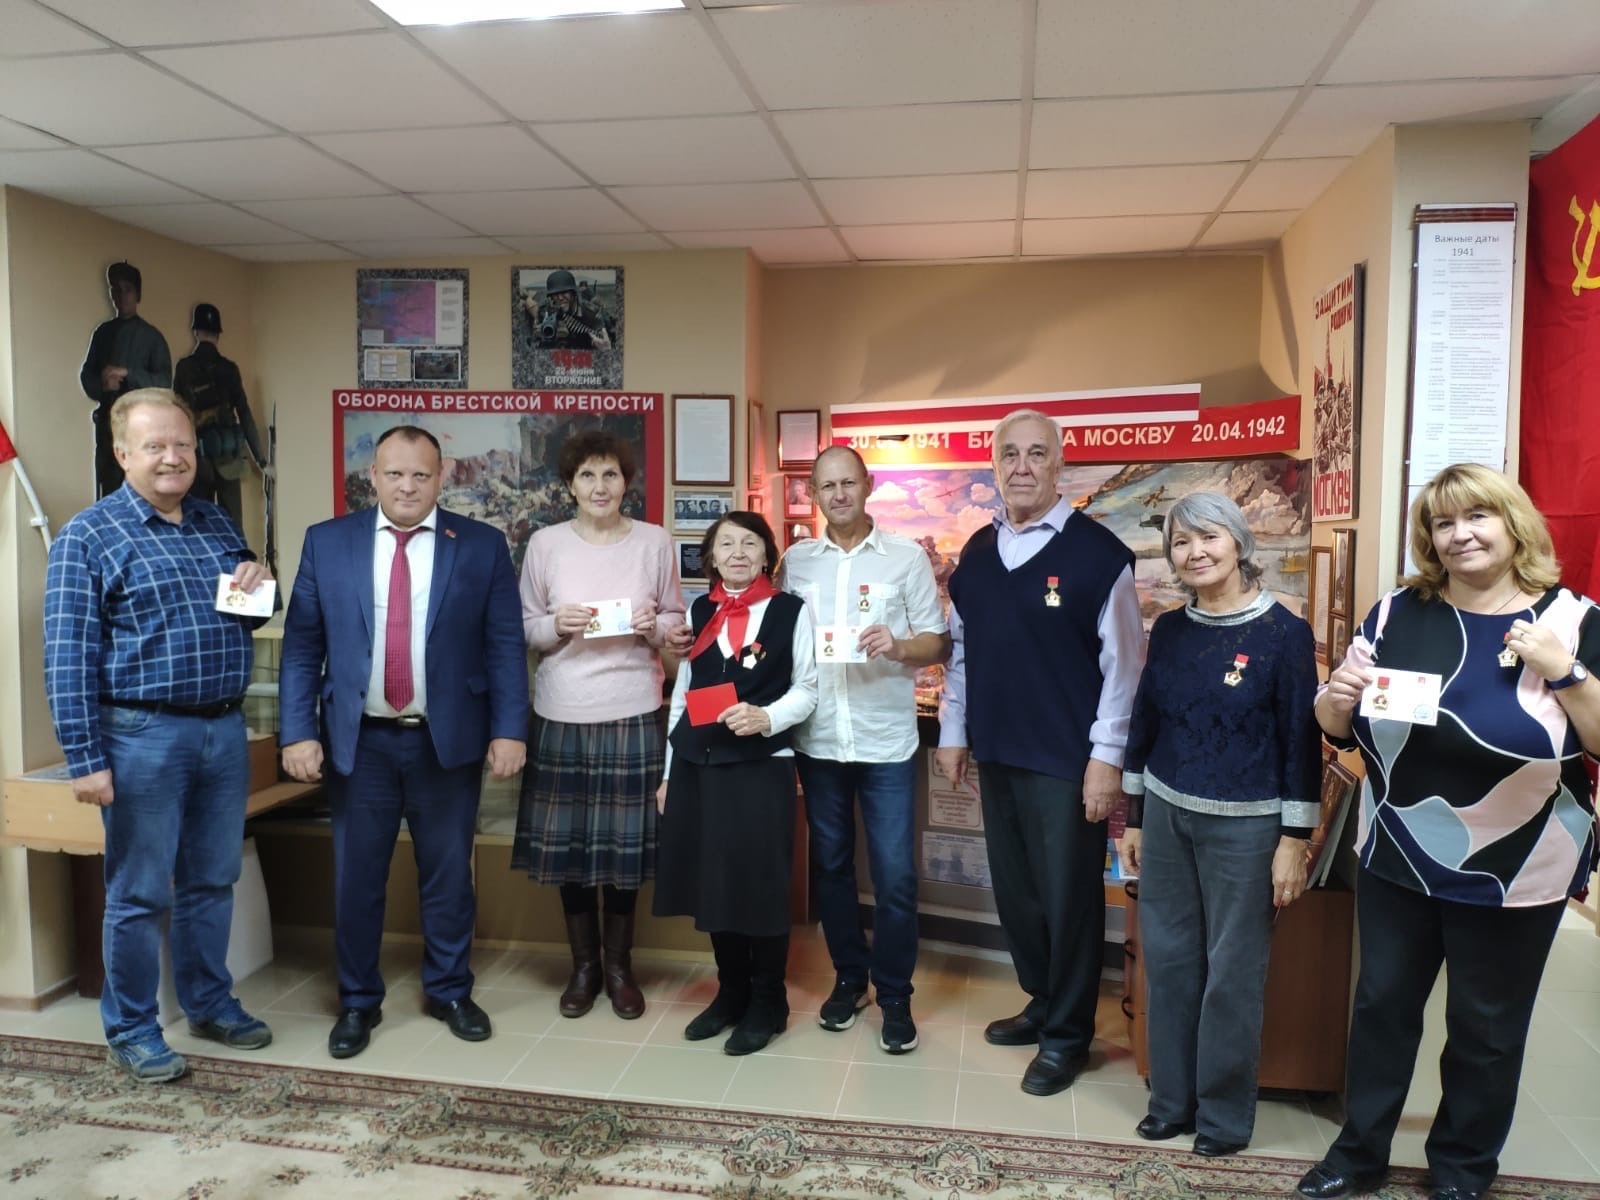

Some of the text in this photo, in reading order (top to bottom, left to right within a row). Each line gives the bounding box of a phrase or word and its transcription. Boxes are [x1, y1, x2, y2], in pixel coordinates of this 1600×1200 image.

[1434, 234, 1500, 244] Важные даты
[1451, 247, 1474, 256] 1941
[1315, 274, 1353, 320] ЗАЩИТИМ
[544, 375, 602, 385] ВТОРЖЕНИЕ
[338, 392, 654, 410] ОБОРОНА БРЕСТСКОЙ КРЕПОСТИ
[1084, 425, 1176, 446] МОСКВУ
[1191, 415, 1286, 443] 20.04.1942
[1313, 468, 1351, 517] МОСКВУ
